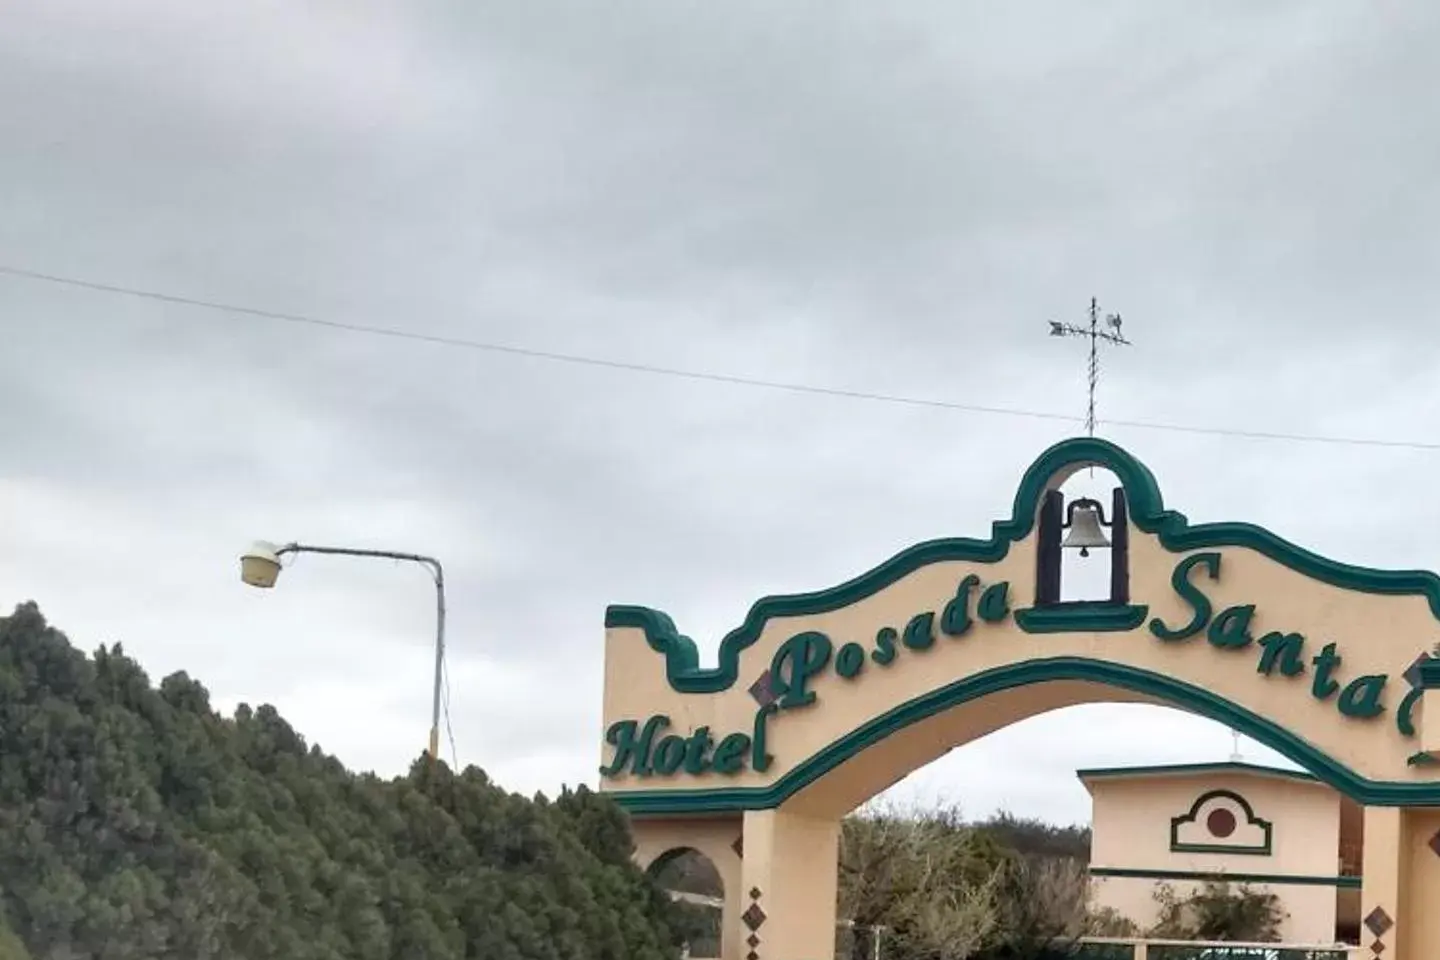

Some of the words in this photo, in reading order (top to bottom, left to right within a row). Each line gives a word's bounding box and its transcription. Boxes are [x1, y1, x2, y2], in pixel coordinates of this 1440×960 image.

[599, 703, 778, 777] Hotel
[770, 574, 1012, 708] Posada
[1150, 552, 1389, 719] Santa
